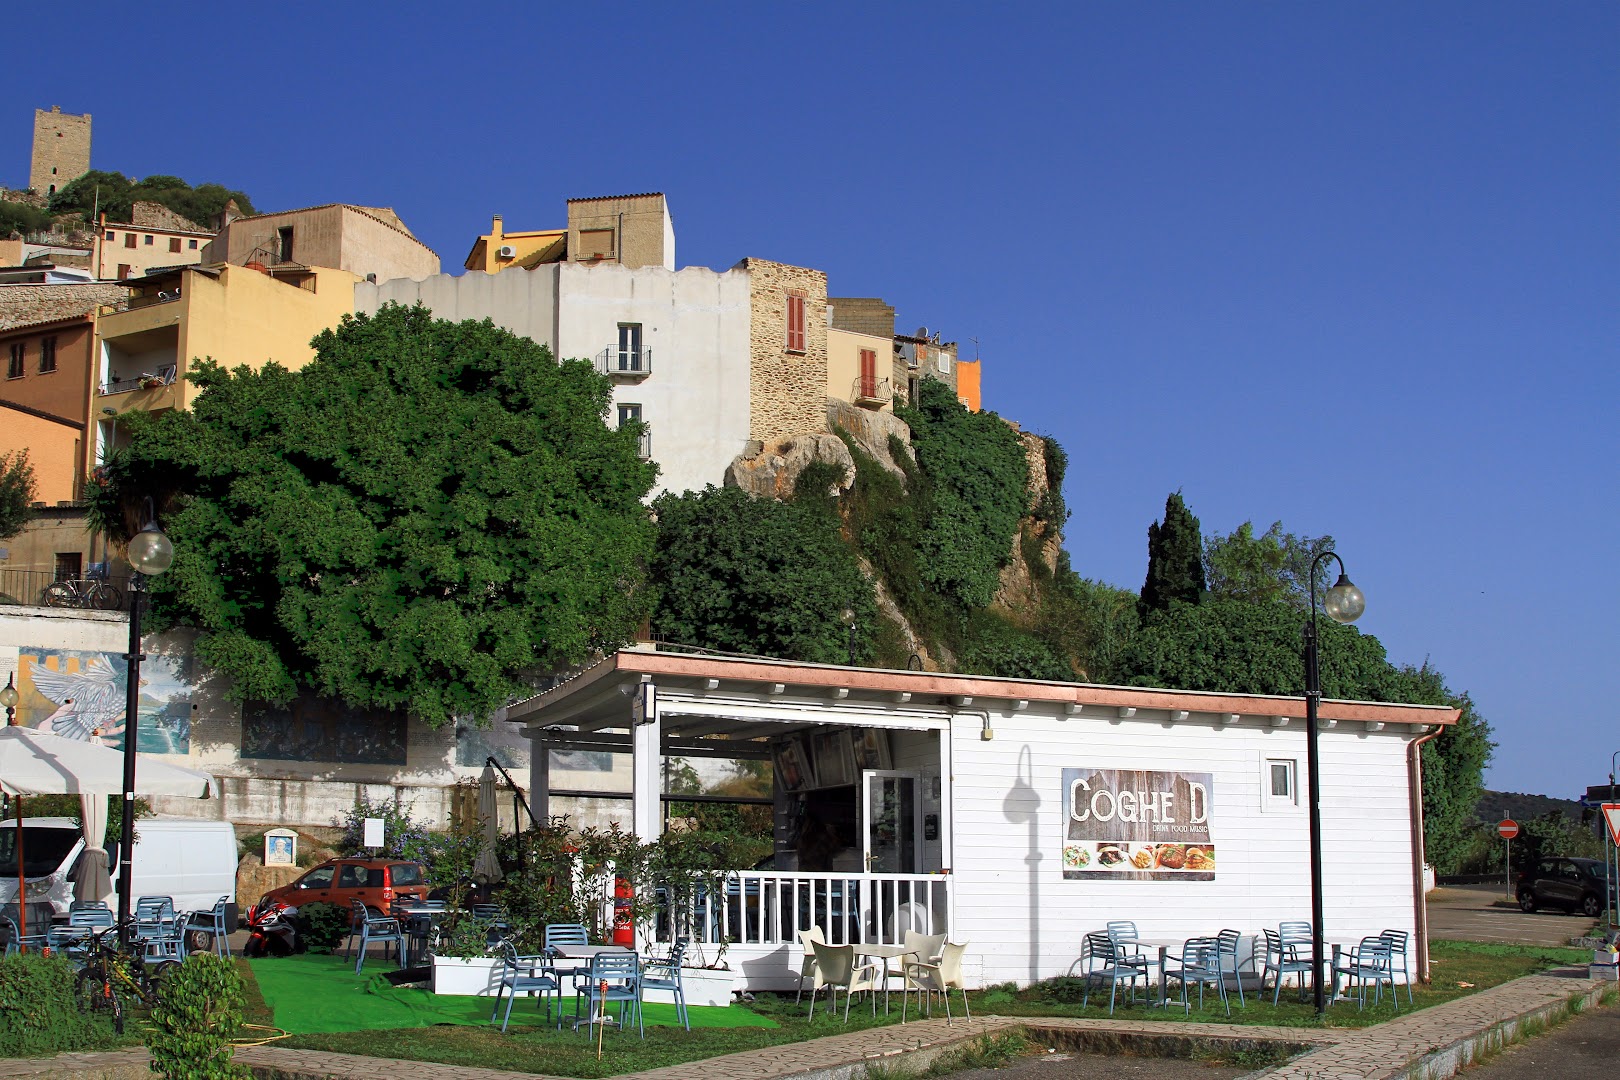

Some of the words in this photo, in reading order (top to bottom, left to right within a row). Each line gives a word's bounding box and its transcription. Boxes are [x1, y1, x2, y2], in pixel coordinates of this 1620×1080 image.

[1070, 778, 1175, 823] COGHE
[1189, 782, 1207, 823] D
[1189, 825, 1208, 833] MUSIC
